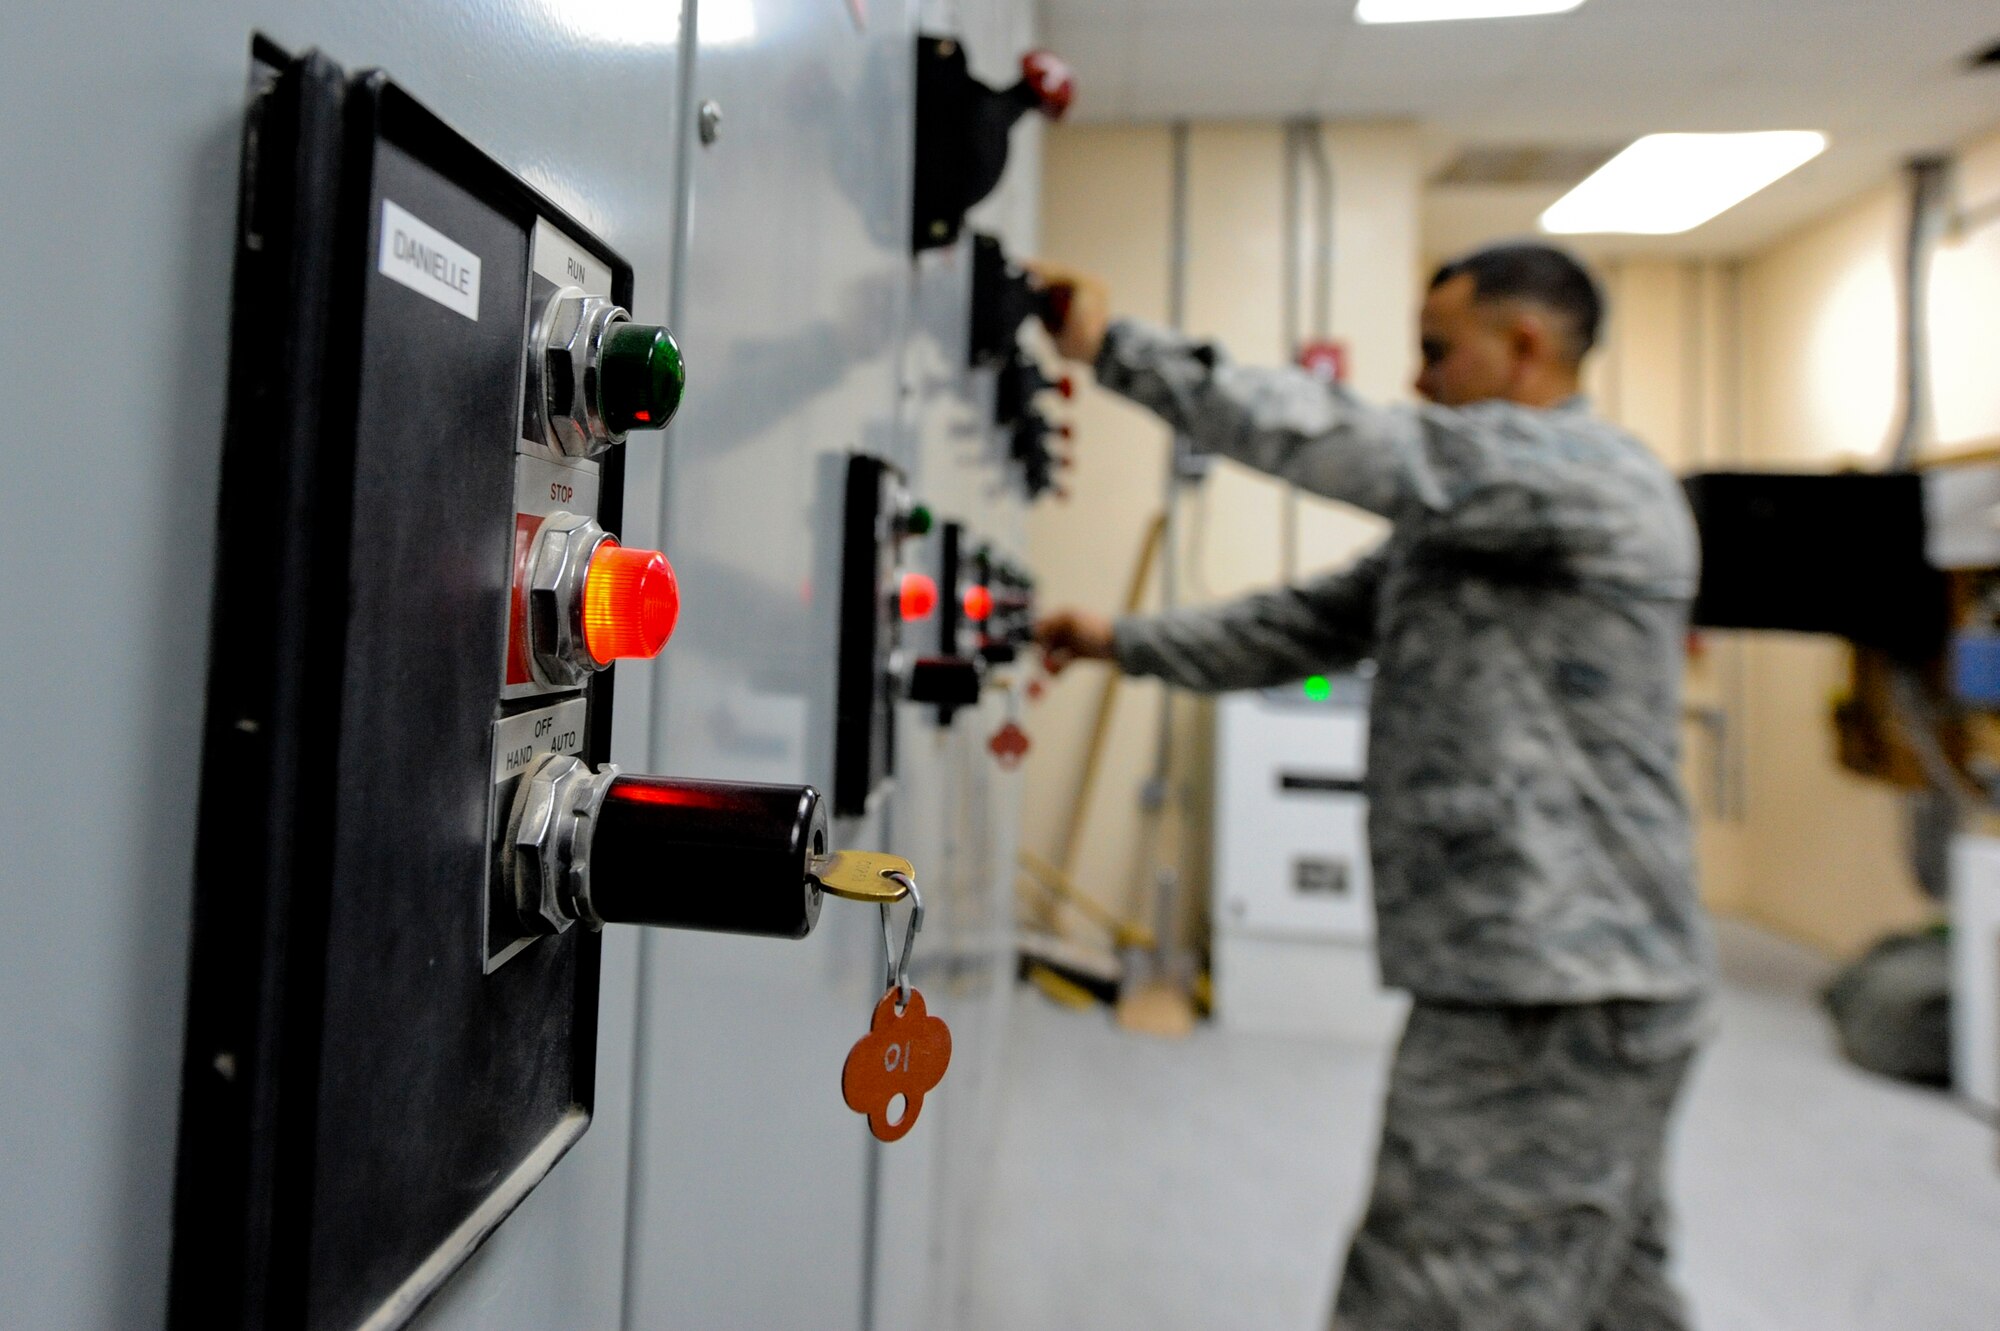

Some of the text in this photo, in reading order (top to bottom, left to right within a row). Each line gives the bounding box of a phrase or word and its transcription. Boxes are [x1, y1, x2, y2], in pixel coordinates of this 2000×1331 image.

[393, 229, 470, 296] DANIELLE
[567, 256, 586, 284] RUN
[550, 482, 573, 503] STOP
[534, 716, 553, 738] OFF
[506, 731, 576, 771] HAND AUTO
